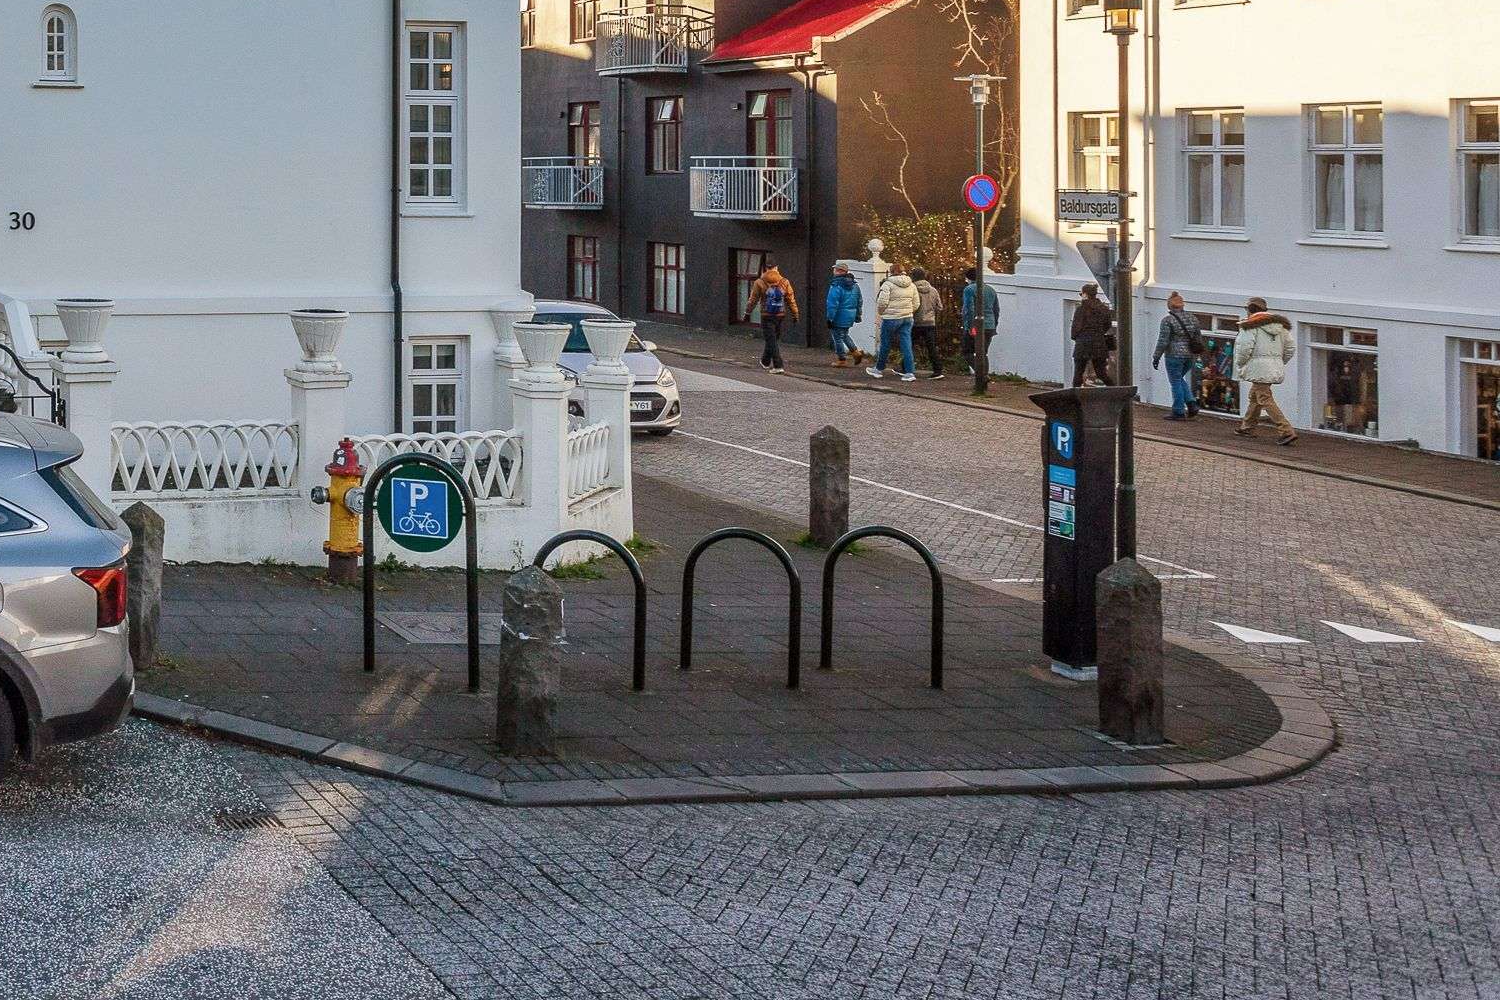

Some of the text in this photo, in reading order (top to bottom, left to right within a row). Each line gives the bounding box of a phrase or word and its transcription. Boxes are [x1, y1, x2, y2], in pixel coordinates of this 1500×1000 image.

[1060, 199, 1118, 218] Baldursgata
[9, 211, 36, 230] 30
[410, 482, 429, 508] P
